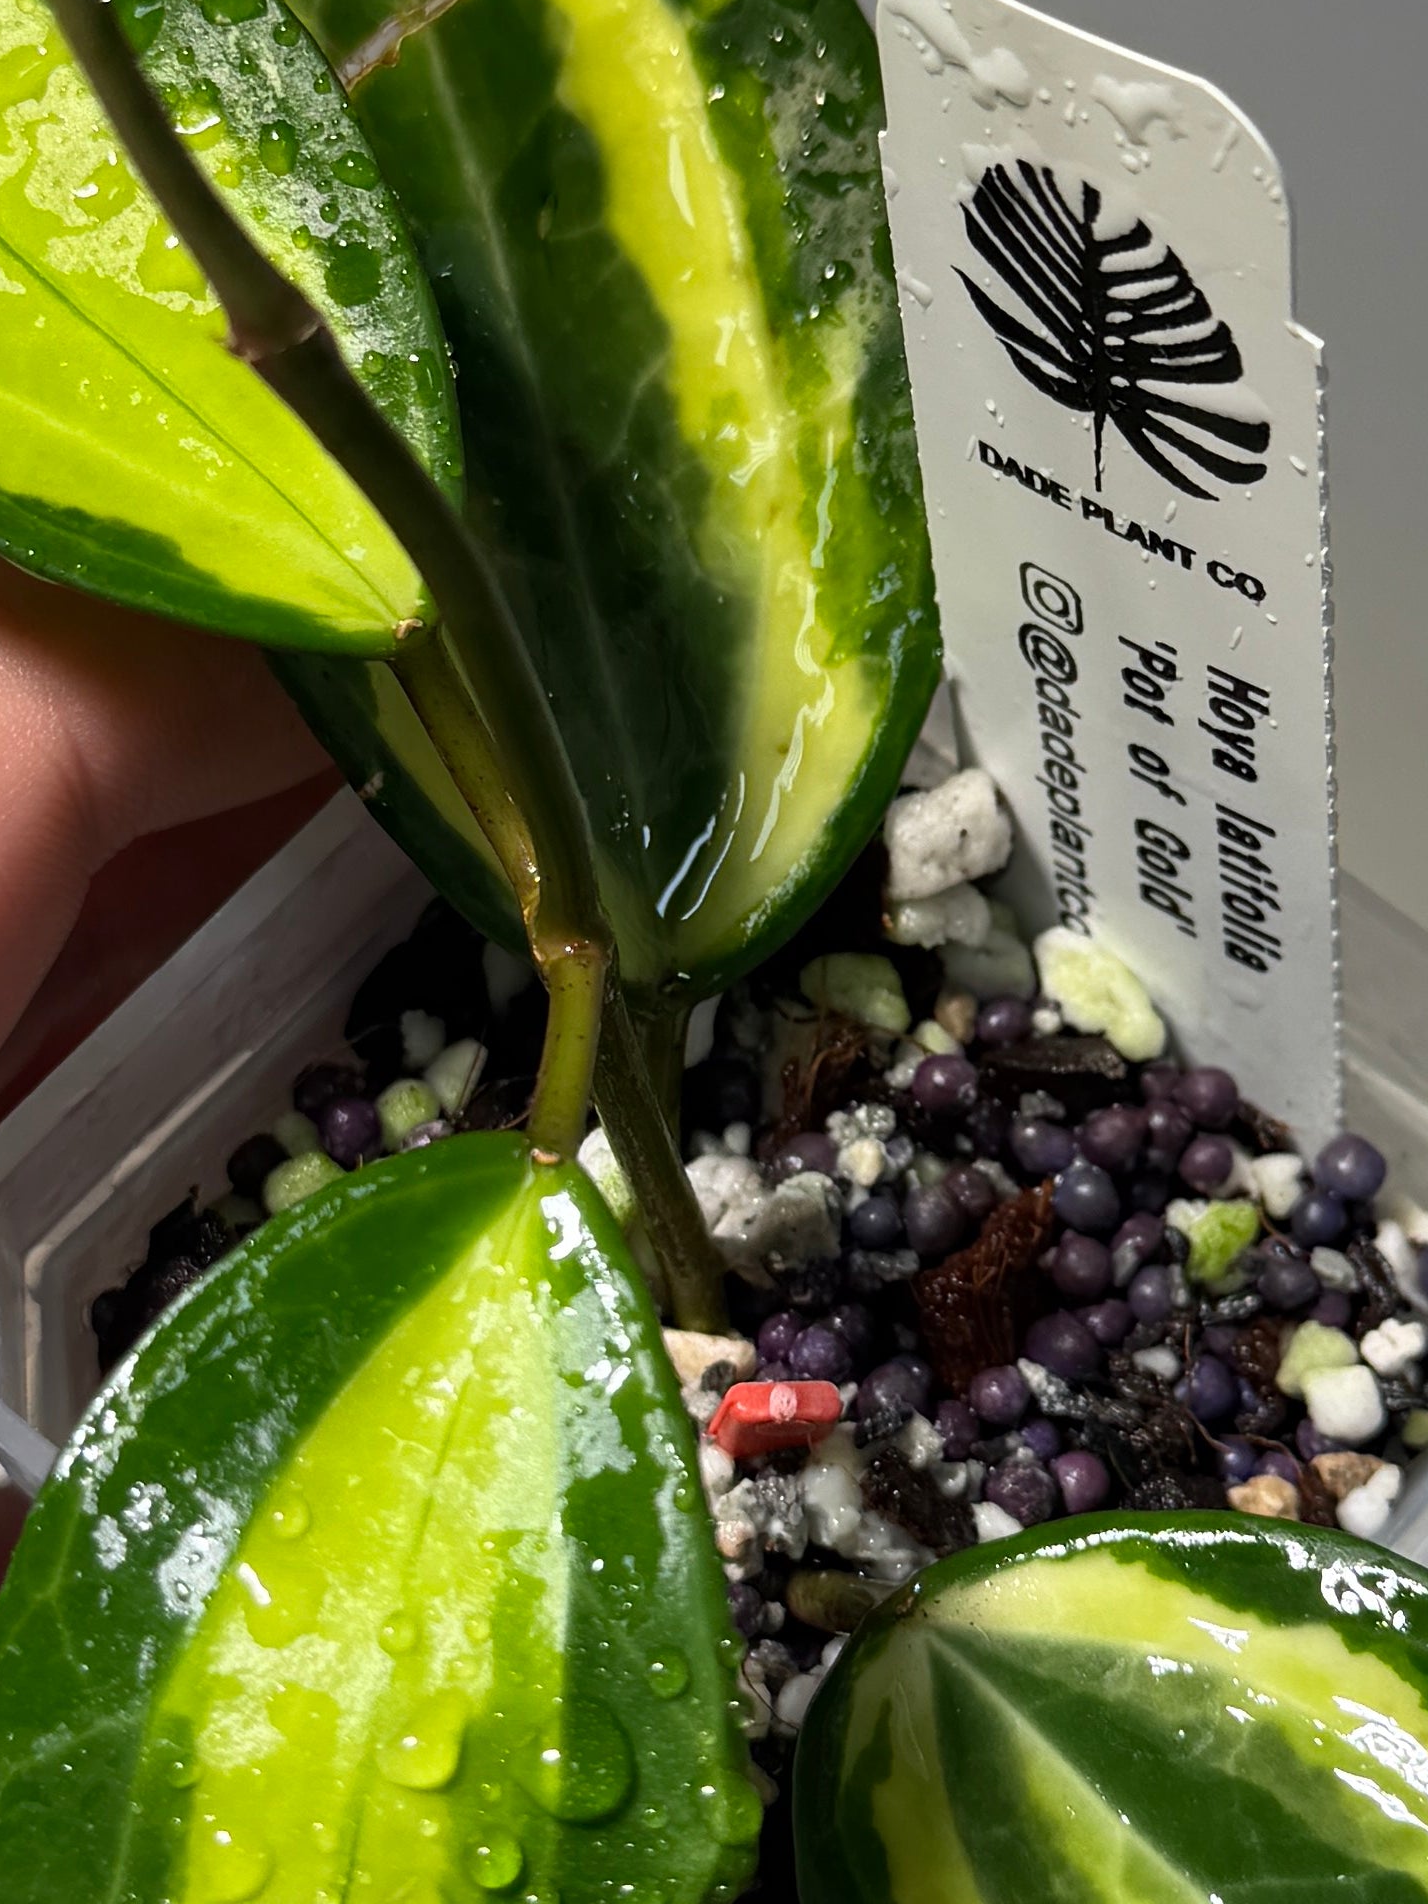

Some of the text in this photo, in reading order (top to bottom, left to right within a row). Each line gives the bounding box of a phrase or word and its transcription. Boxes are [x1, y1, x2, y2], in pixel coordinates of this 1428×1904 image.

[978, 439, 1267, 602] DADE PLANT CO
[1118, 635, 1198, 939] 'Pot of Gold'
[1198, 665, 1284, 973] Hoya latifolia
